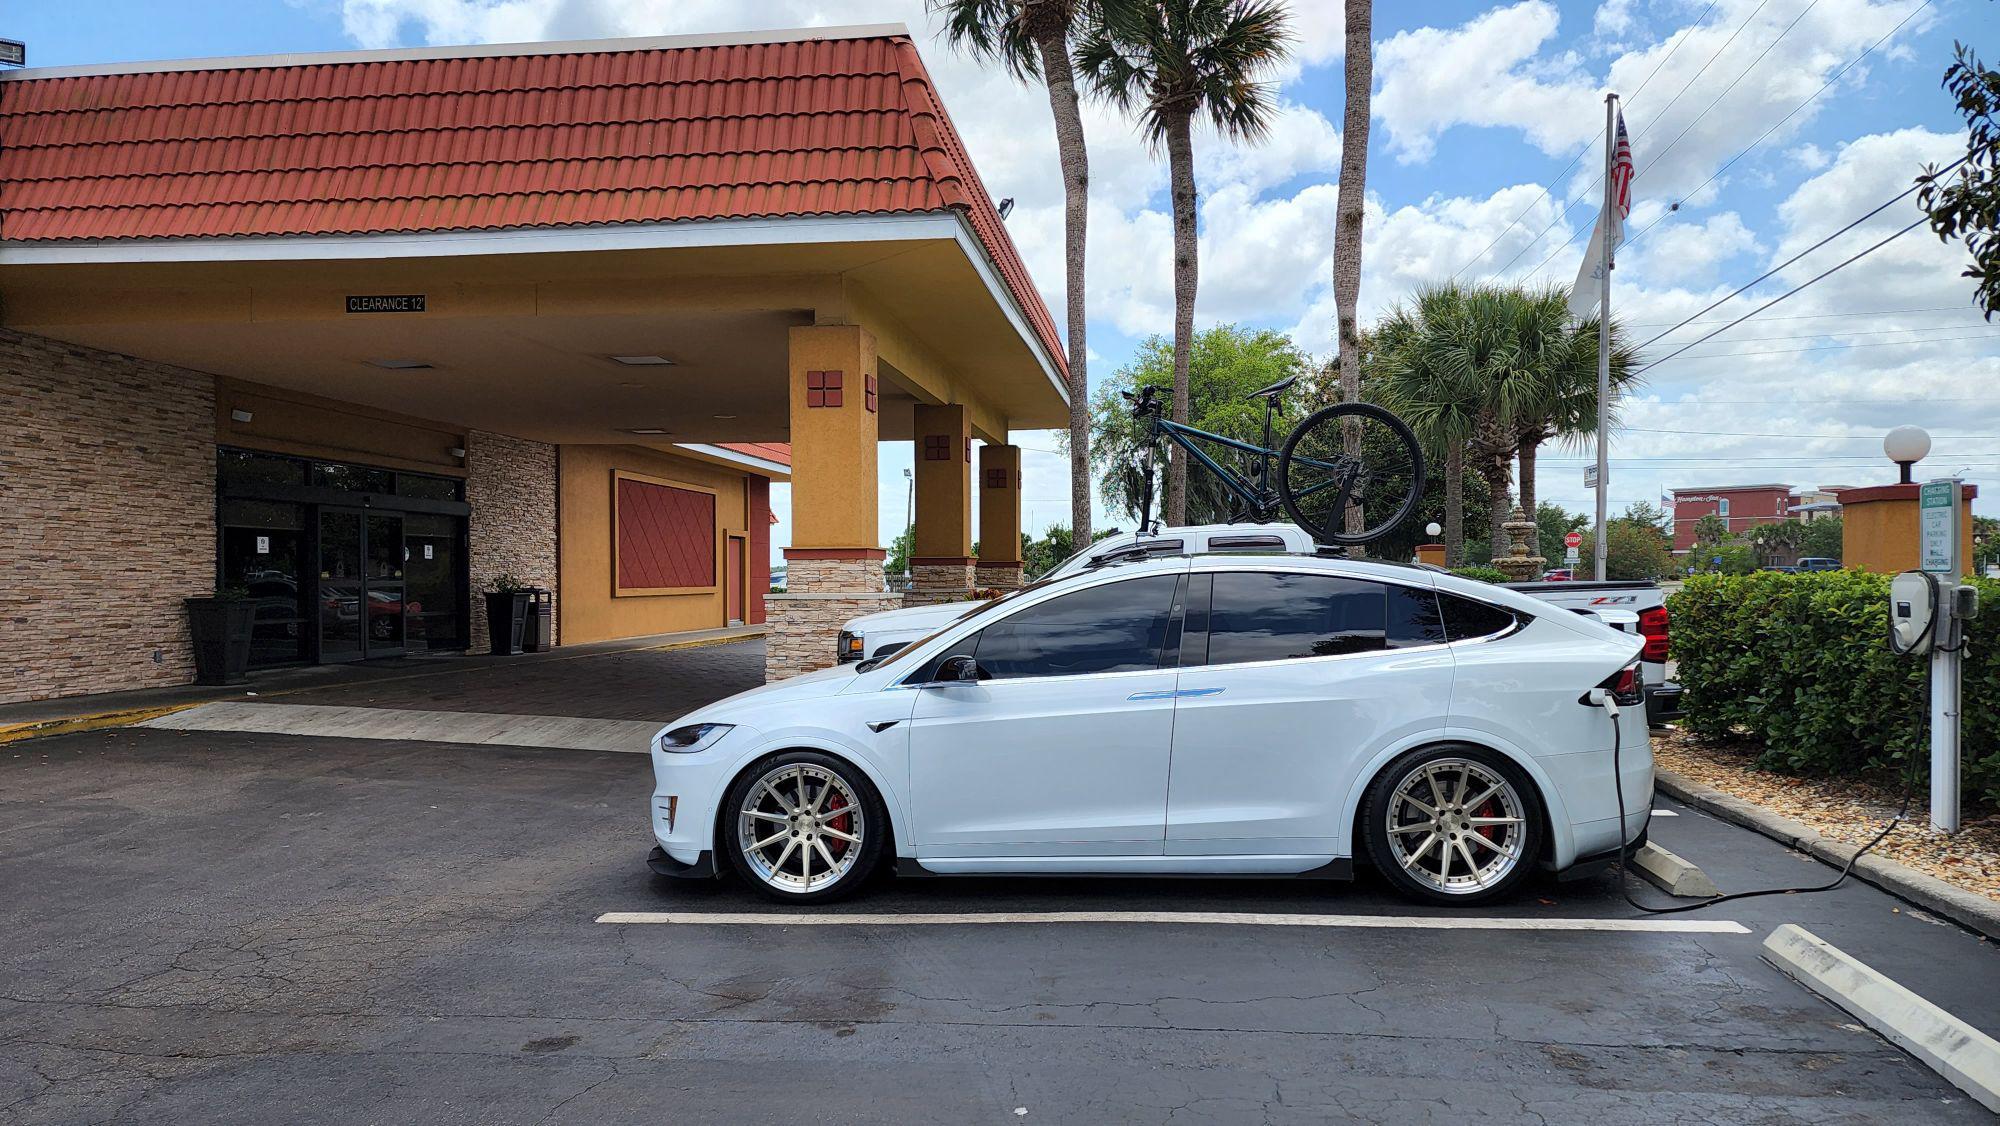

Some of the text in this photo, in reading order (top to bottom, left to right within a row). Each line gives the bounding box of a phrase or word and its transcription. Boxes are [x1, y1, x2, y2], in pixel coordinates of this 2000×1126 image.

[351, 298, 409, 311] CLEARANCE
[1924, 486, 1950, 496] CHARGING
[1927, 497, 1948, 506] STATION
[1926, 512, 1947, 520] ELECTRIC
[1926, 530, 1947, 538] PARKING
[1589, 596, 1637, 605] Z71
